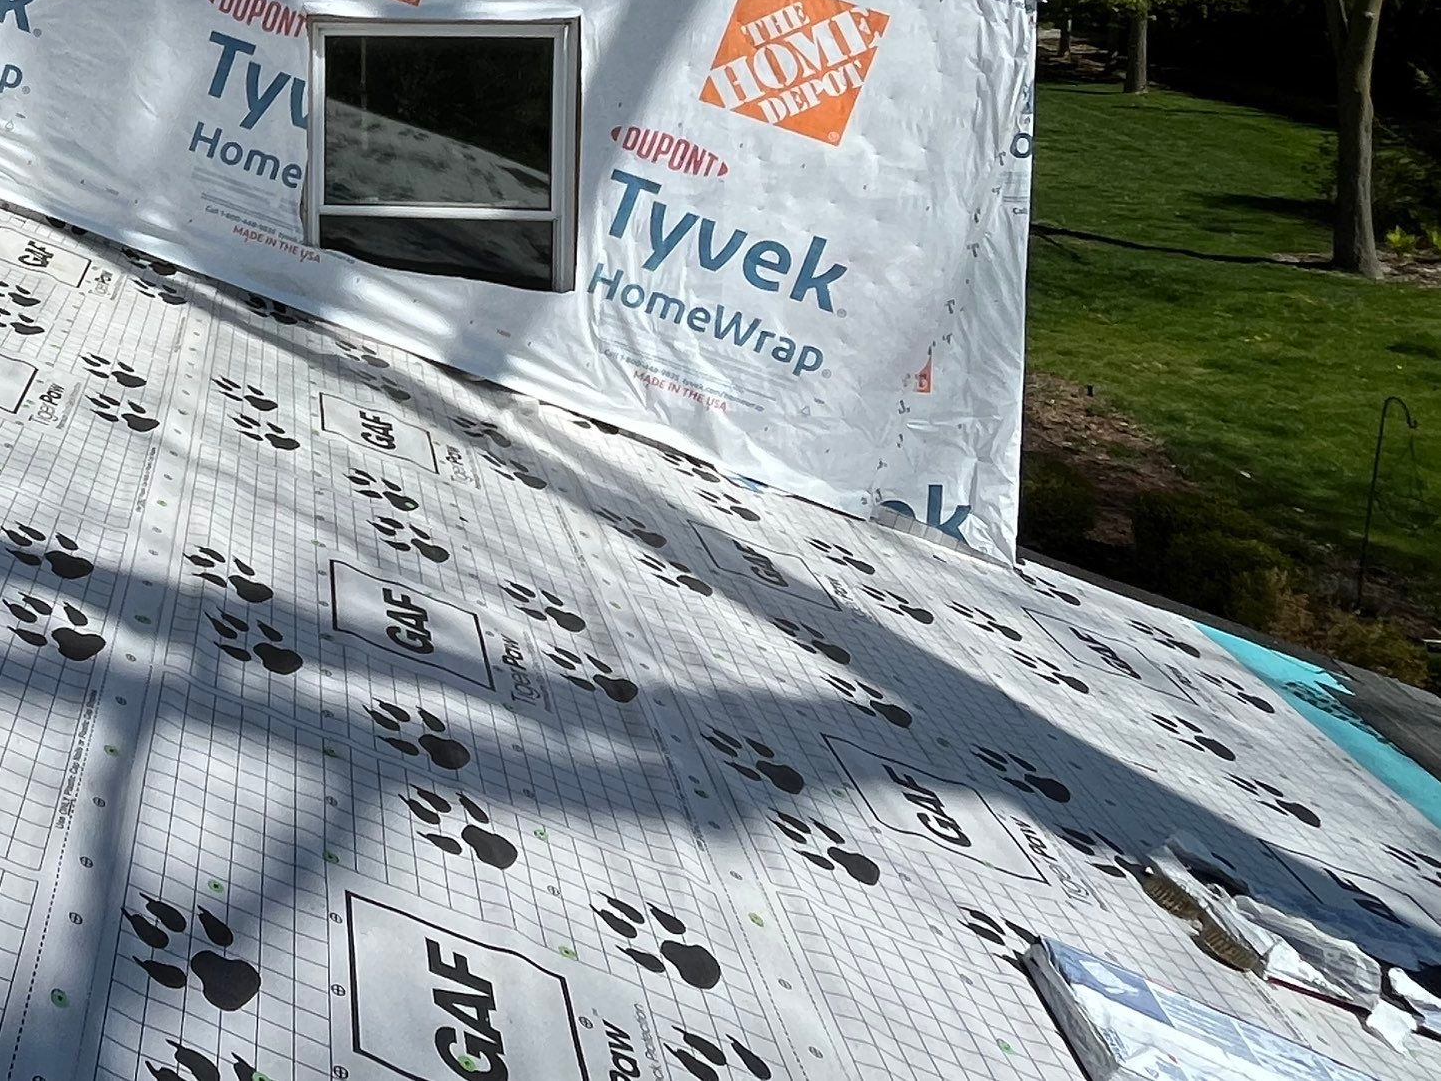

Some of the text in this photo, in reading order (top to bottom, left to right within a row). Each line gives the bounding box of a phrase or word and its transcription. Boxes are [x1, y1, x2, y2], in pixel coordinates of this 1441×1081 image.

[740, 1, 810, 47] THE
[709, 6, 883, 111] HOME
[758, 60, 865, 124] DEPOT
[188, 121, 303, 189] Home
[622, 126, 719, 177] DUPONT
[204, 204, 219, 214] Call
[609, 169, 848, 313] Tyvek
[18, 240, 54, 268] GAF
[232, 225, 262, 242] MADE
[264, 236, 276, 247] IN
[277, 241, 298, 255] THE
[299, 248, 322, 264] USA
[587, 262, 825, 377] HomeWrap
[29, 383, 65, 427] TigerPaw
[632, 370, 728, 411] MADE IN THE USA
[360, 410, 396, 451] GAF
[732, 539, 788, 587] GAF
[383, 587, 435, 654] GAF
[501, 633, 542, 707] TigerPaw
[54, 815, 66, 829] Use
[68, 761, 80, 774] Cap
[882, 763, 972, 848] GAF
[1011, 816, 1093, 905] TigerPaw
[425, 936, 509, 1081] GAF
